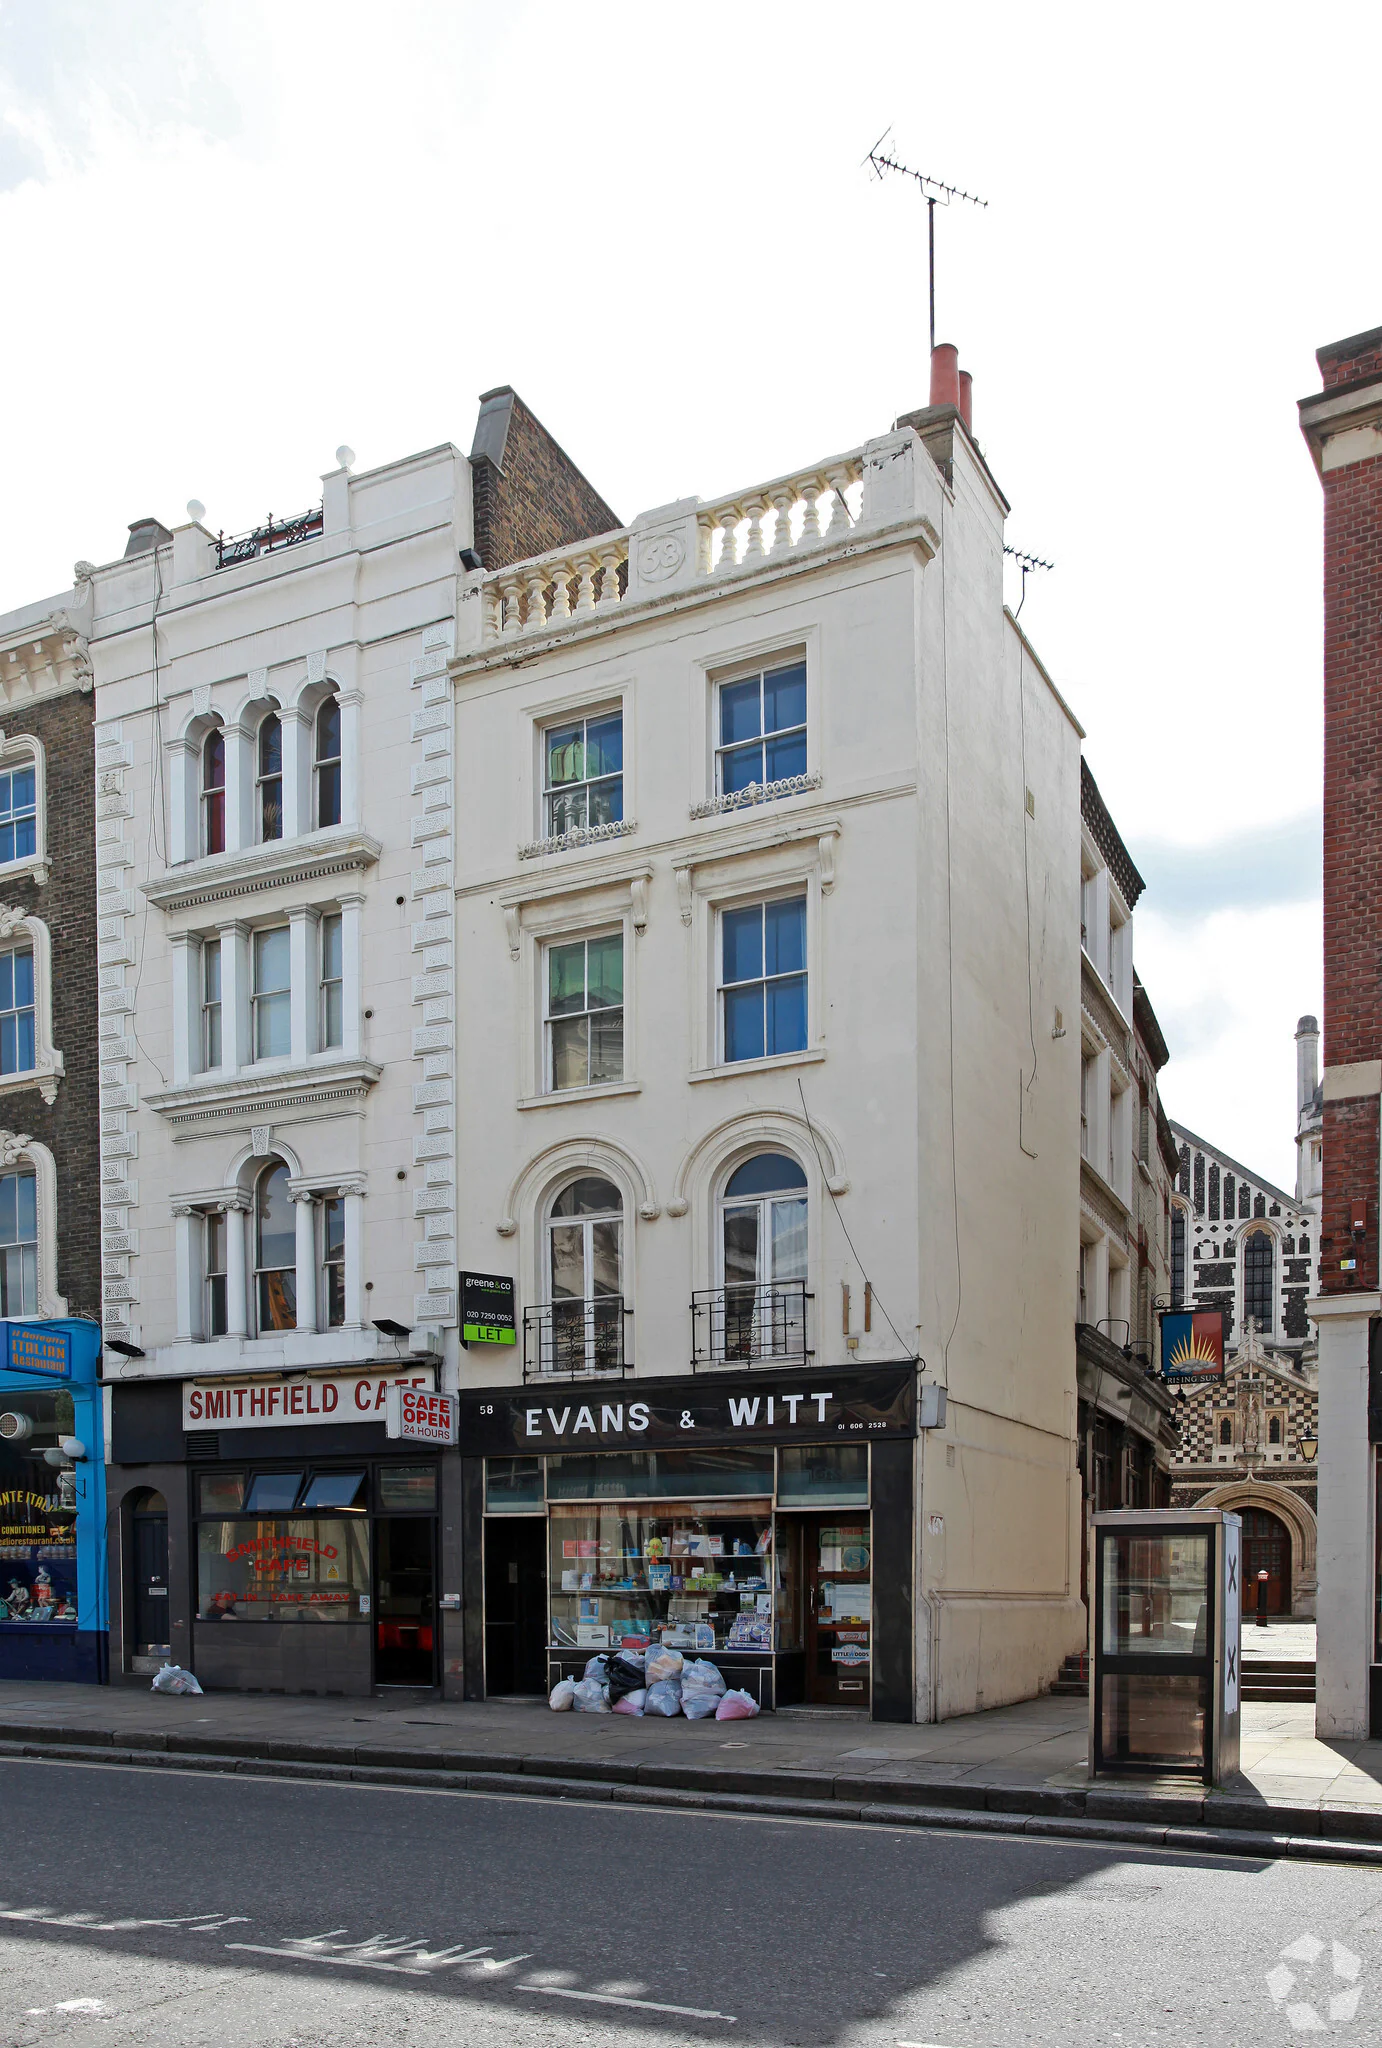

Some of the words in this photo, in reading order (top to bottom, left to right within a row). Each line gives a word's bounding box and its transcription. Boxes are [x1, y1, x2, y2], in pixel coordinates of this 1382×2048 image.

[465, 1278, 511, 1290] greene&co
[466, 1310, 479, 1318] 020
[480, 1312, 496, 1320] 7250
[497, 1314, 512, 1322] 0052
[478, 1327, 503, 1340] LET
[12, 1339, 65, 1359] ITALIAN
[1167, 1375, 1198, 1384] RISING
[1200, 1374, 1219, 1382] SUN
[189, 1383, 339, 1419] SMITHFIELD
[355, 1378, 426, 1411] CA
[403, 1392, 450, 1414] CAFE
[479, 1405, 494, 1415] 58
[526, 1403, 650, 1436] EVANS
[679, 1410, 696, 1429] &
[728, 1392, 833, 1426] WITT
[403, 1408, 450, 1429] OPEN
[404, 1424, 415, 1434] 24
[417, 1427, 450, 1440] HOURS
[849, 1422, 864, 1430] 606
[868, 1421, 887, 1429] 2528
[1, 1525, 46, 1535] CONDITIONED
[225, 1536, 338, 1563] SMITHFIELD
[254, 1559, 309, 1572] CAFE
[215, 1593, 237, 1601] EAT
[243, 1593, 257, 1601] IN
[271, 1593, 305, 1602] TAKE
[309, 1593, 351, 1602] AWAY
[832, 1649, 870, 1657] LITTLEWOODS
